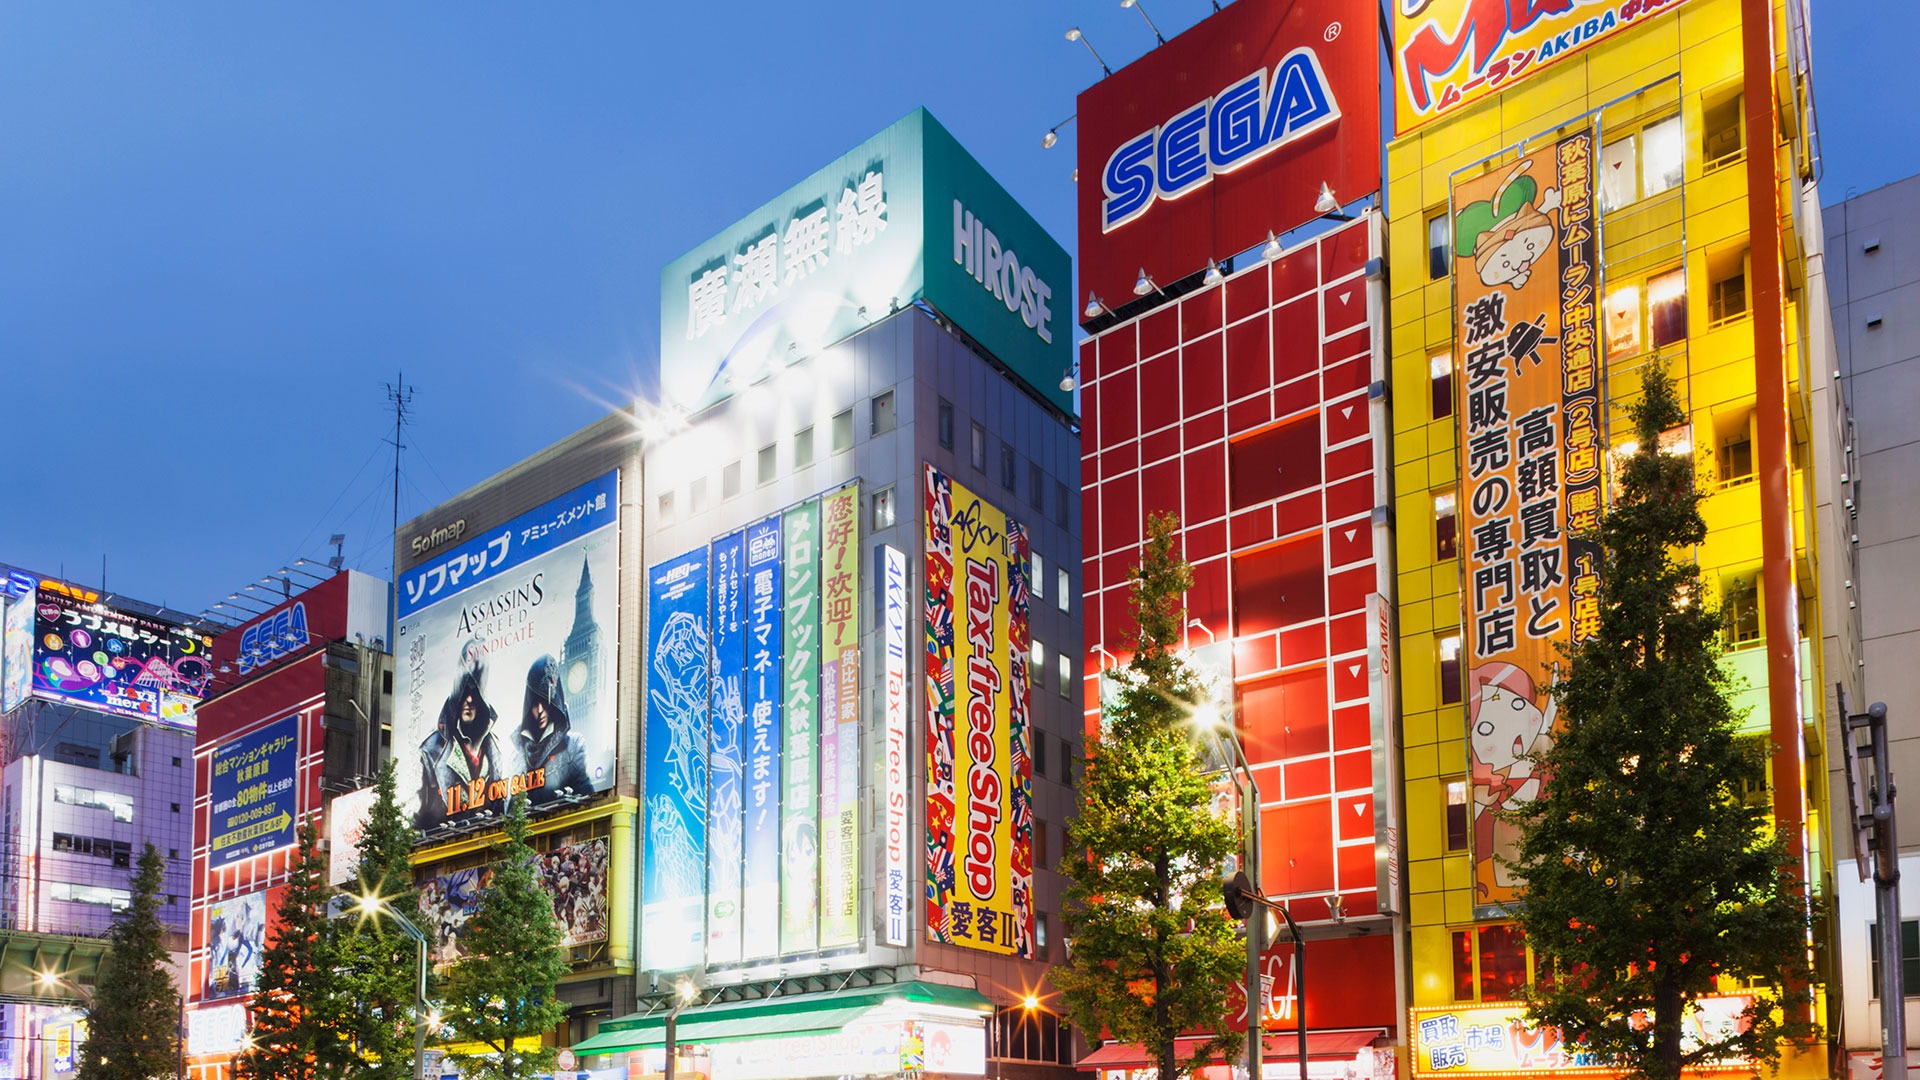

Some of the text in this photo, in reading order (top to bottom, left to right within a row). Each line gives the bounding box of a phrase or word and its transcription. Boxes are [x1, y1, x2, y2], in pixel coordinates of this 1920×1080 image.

[1437, 50, 1536, 111] ムーラン
[1538, 10, 1616, 62] AKIBA
[1101, 45, 1343, 235] SEGA
[685, 170, 888, 342] 廣瀬無線
[953, 198, 1052, 345] HIROSE
[1465, 292, 1517, 658] 激安販売の専門店
[411, 518, 466, 557] Sofmap
[951, 510, 999, 546] AKKY
[1514, 404, 1564, 637] 高額買取と
[406, 492, 607, 605] ソフマップ アミューズメント館
[753, 547, 776, 562] money
[37, 593, 73, 607] ADULT
[75, 603, 139, 625] AMUSEMENT
[140, 619, 167, 632] PARK
[729, 545, 739, 633] ゲームセンターを
[62, 608, 172, 646] ラブメルシー
[240, 600, 311, 677] SEGA
[467, 621, 535, 662] SYNDICATE
[474, 609, 528, 641] CREED
[1380, 602, 1389, 676] GAME
[788, 511, 814, 811] メロンブックス秋葉原店
[106, 695, 158, 714] merci
[445, 768, 546, 817] 11.12 ON SALE
[888, 791, 904, 863] Shop
[1388, 856, 1399, 886] CLUB
[190, 1003, 245, 1051] SEGA
[1420, 1015, 1459, 1044] 買取
[1465, 1024, 1504, 1051] 市場
[1431, 1044, 1467, 1070] 販売
